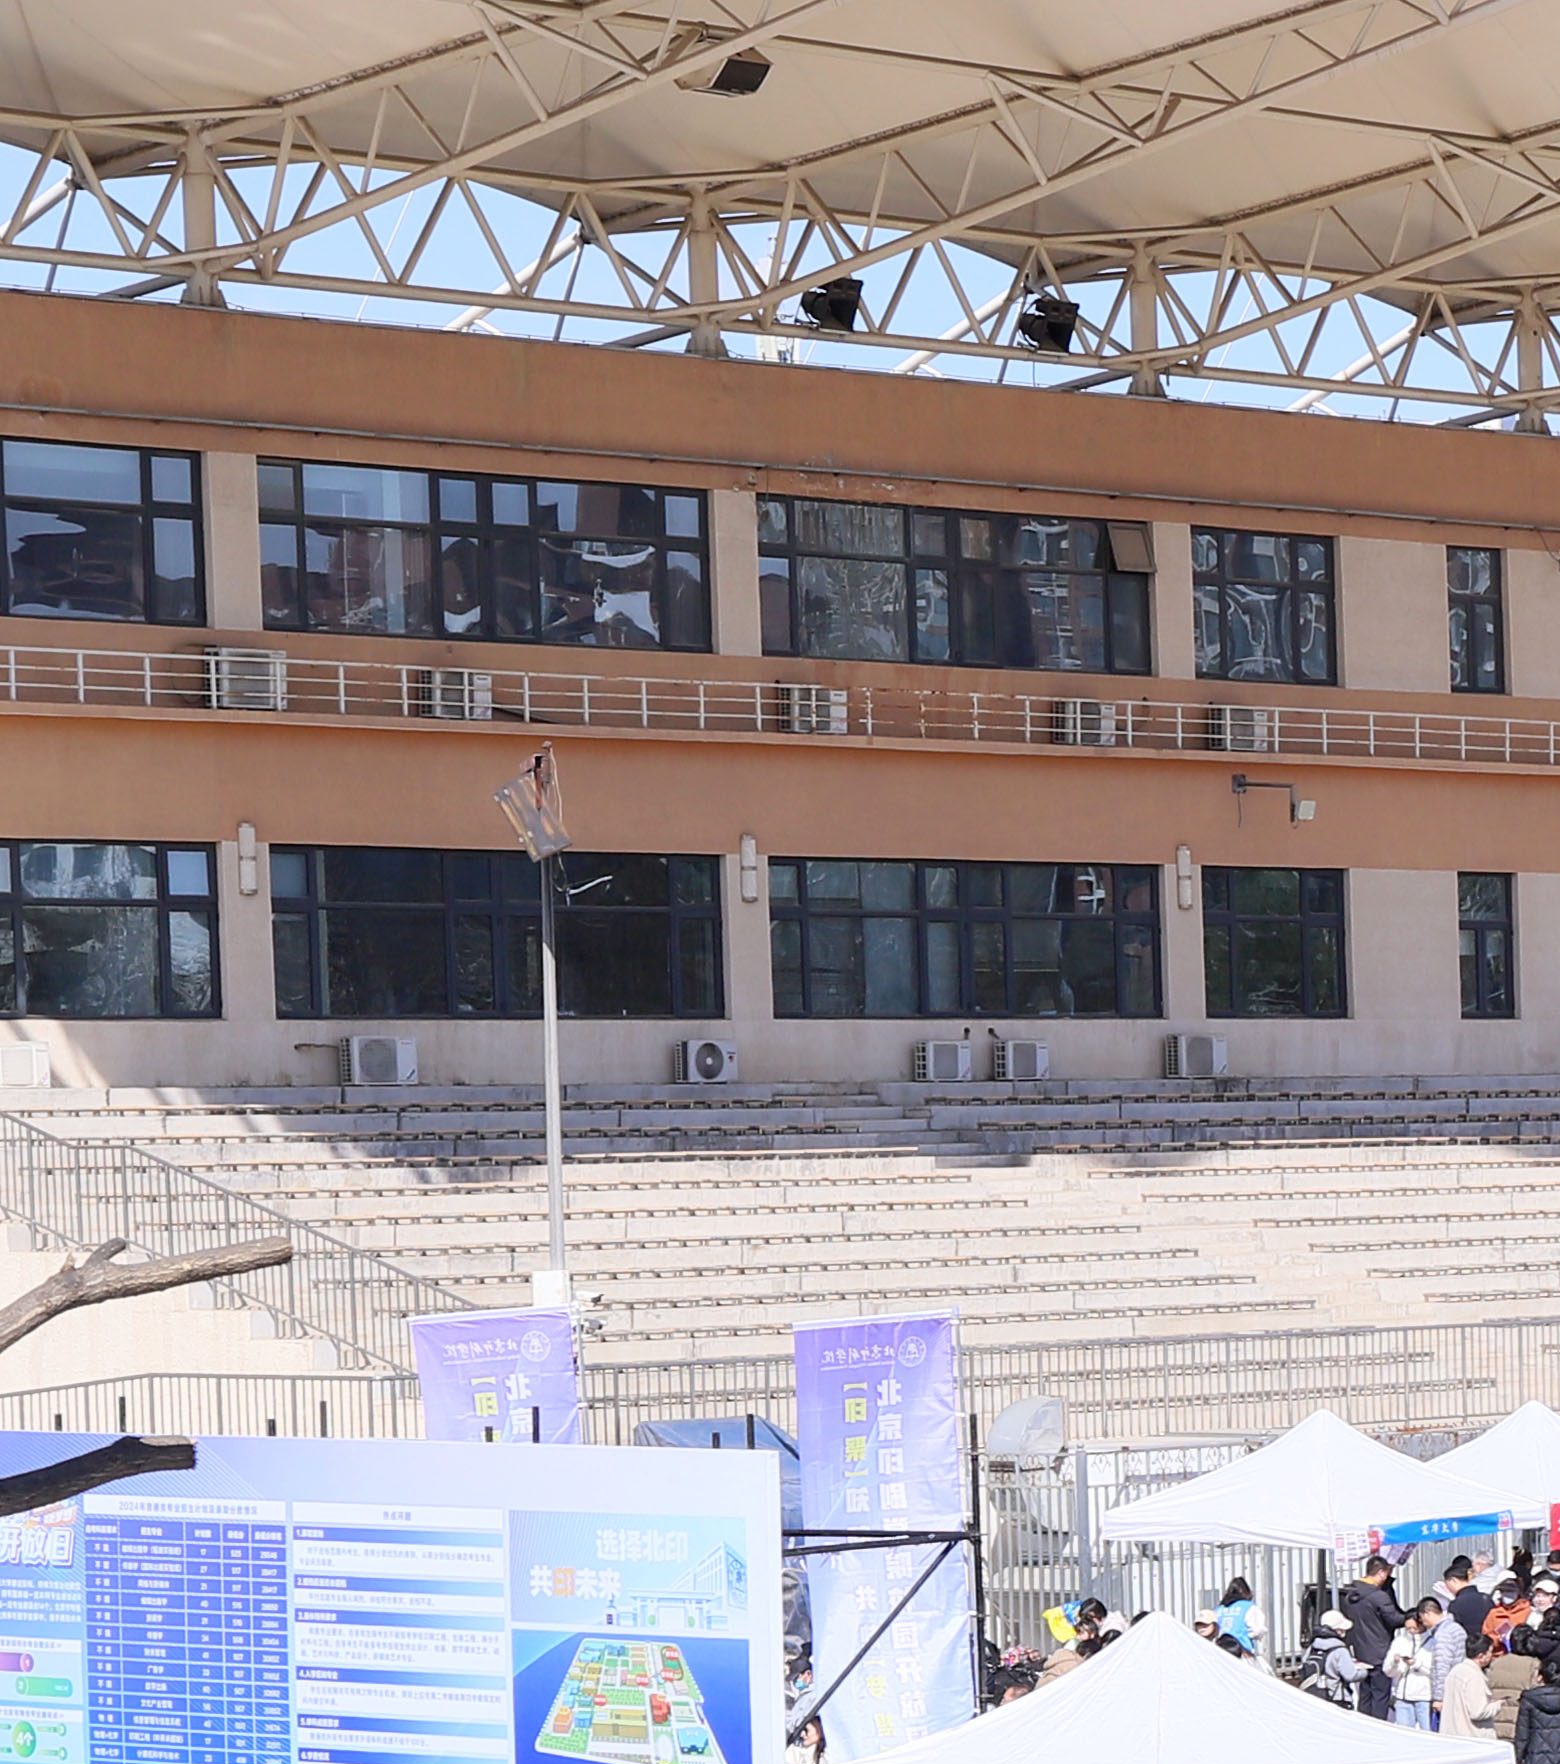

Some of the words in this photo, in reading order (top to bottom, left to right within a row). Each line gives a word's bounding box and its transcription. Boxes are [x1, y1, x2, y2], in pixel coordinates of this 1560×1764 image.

[596, 1528, 689, 1563] 选择北印
[529, 1564, 621, 1600] 共印未来
